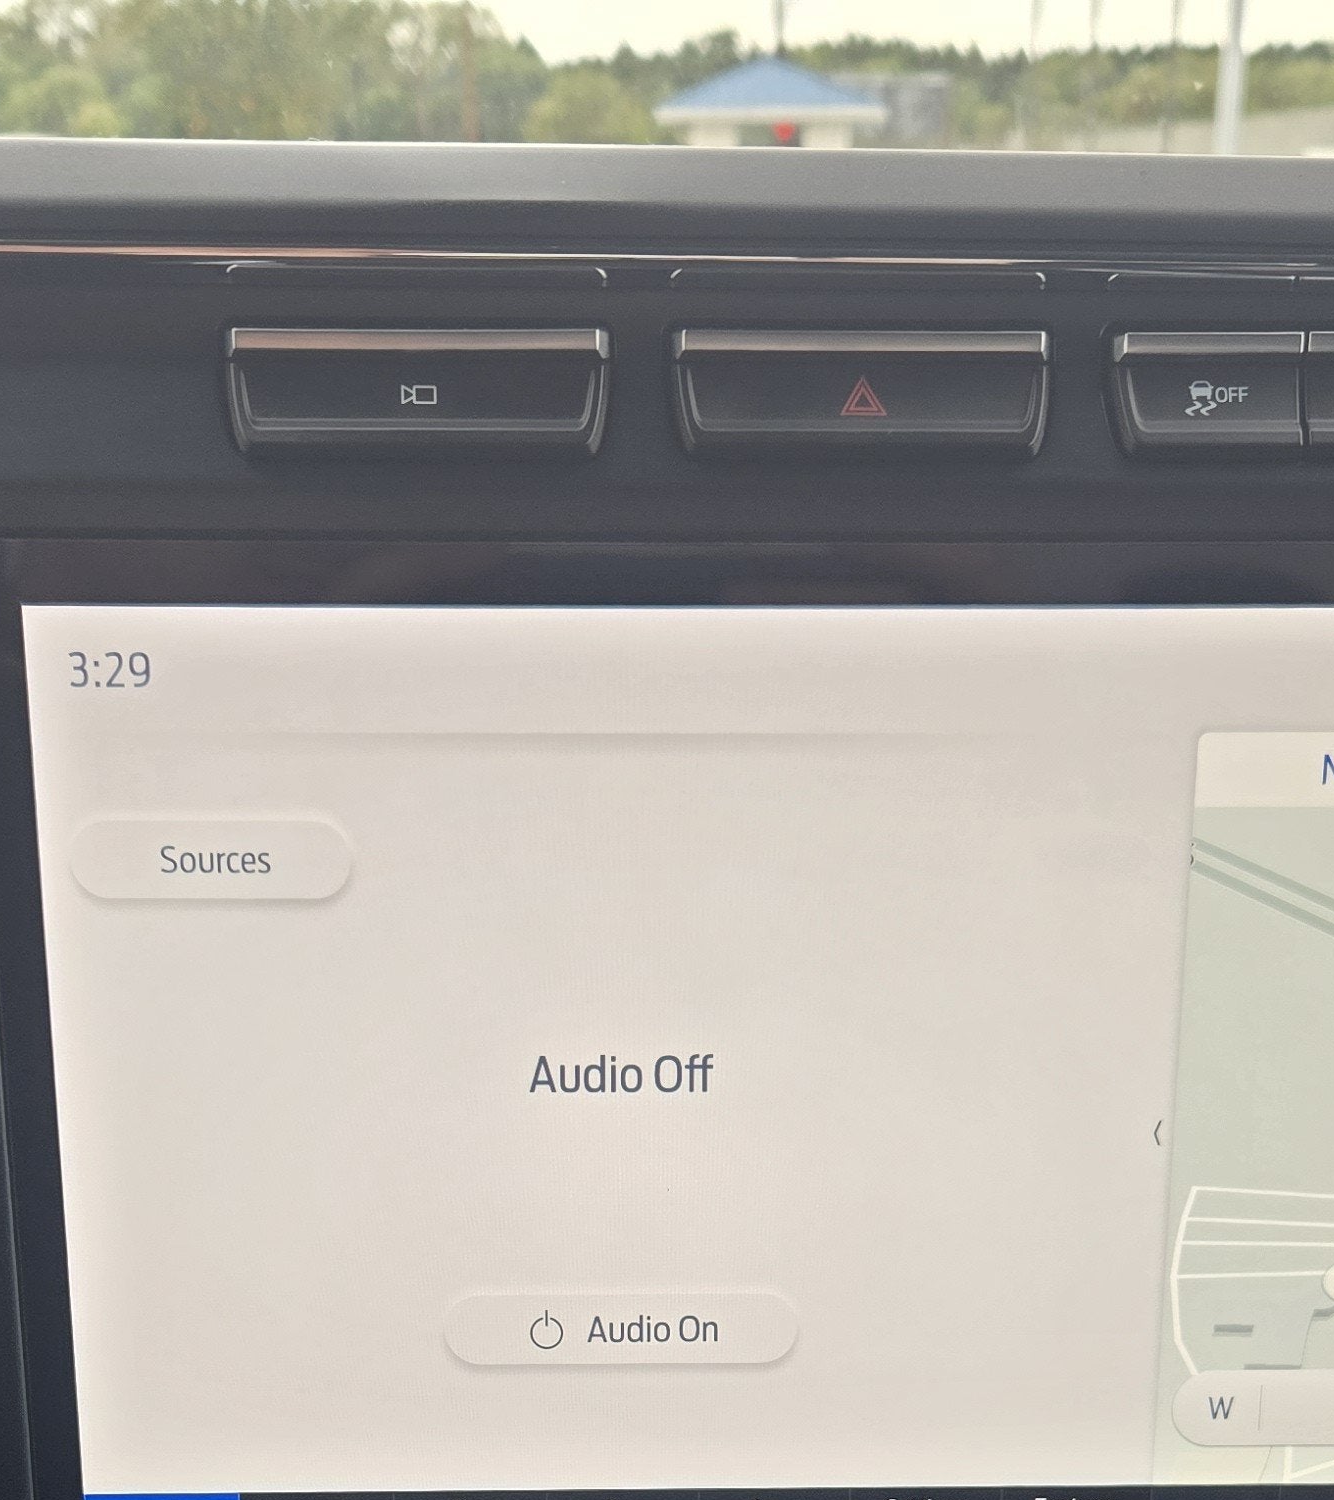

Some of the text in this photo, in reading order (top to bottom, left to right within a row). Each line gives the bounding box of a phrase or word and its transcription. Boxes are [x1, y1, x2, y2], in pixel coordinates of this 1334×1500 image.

[1215, 386, 1249, 403] OFF
[68, 651, 152, 689] 3:29
[159, 845, 272, 875] Sources
[529, 1054, 714, 1094] Audio Off
[587, 1315, 719, 1343] Audio On
[1208, 1396, 1235, 1420] W
